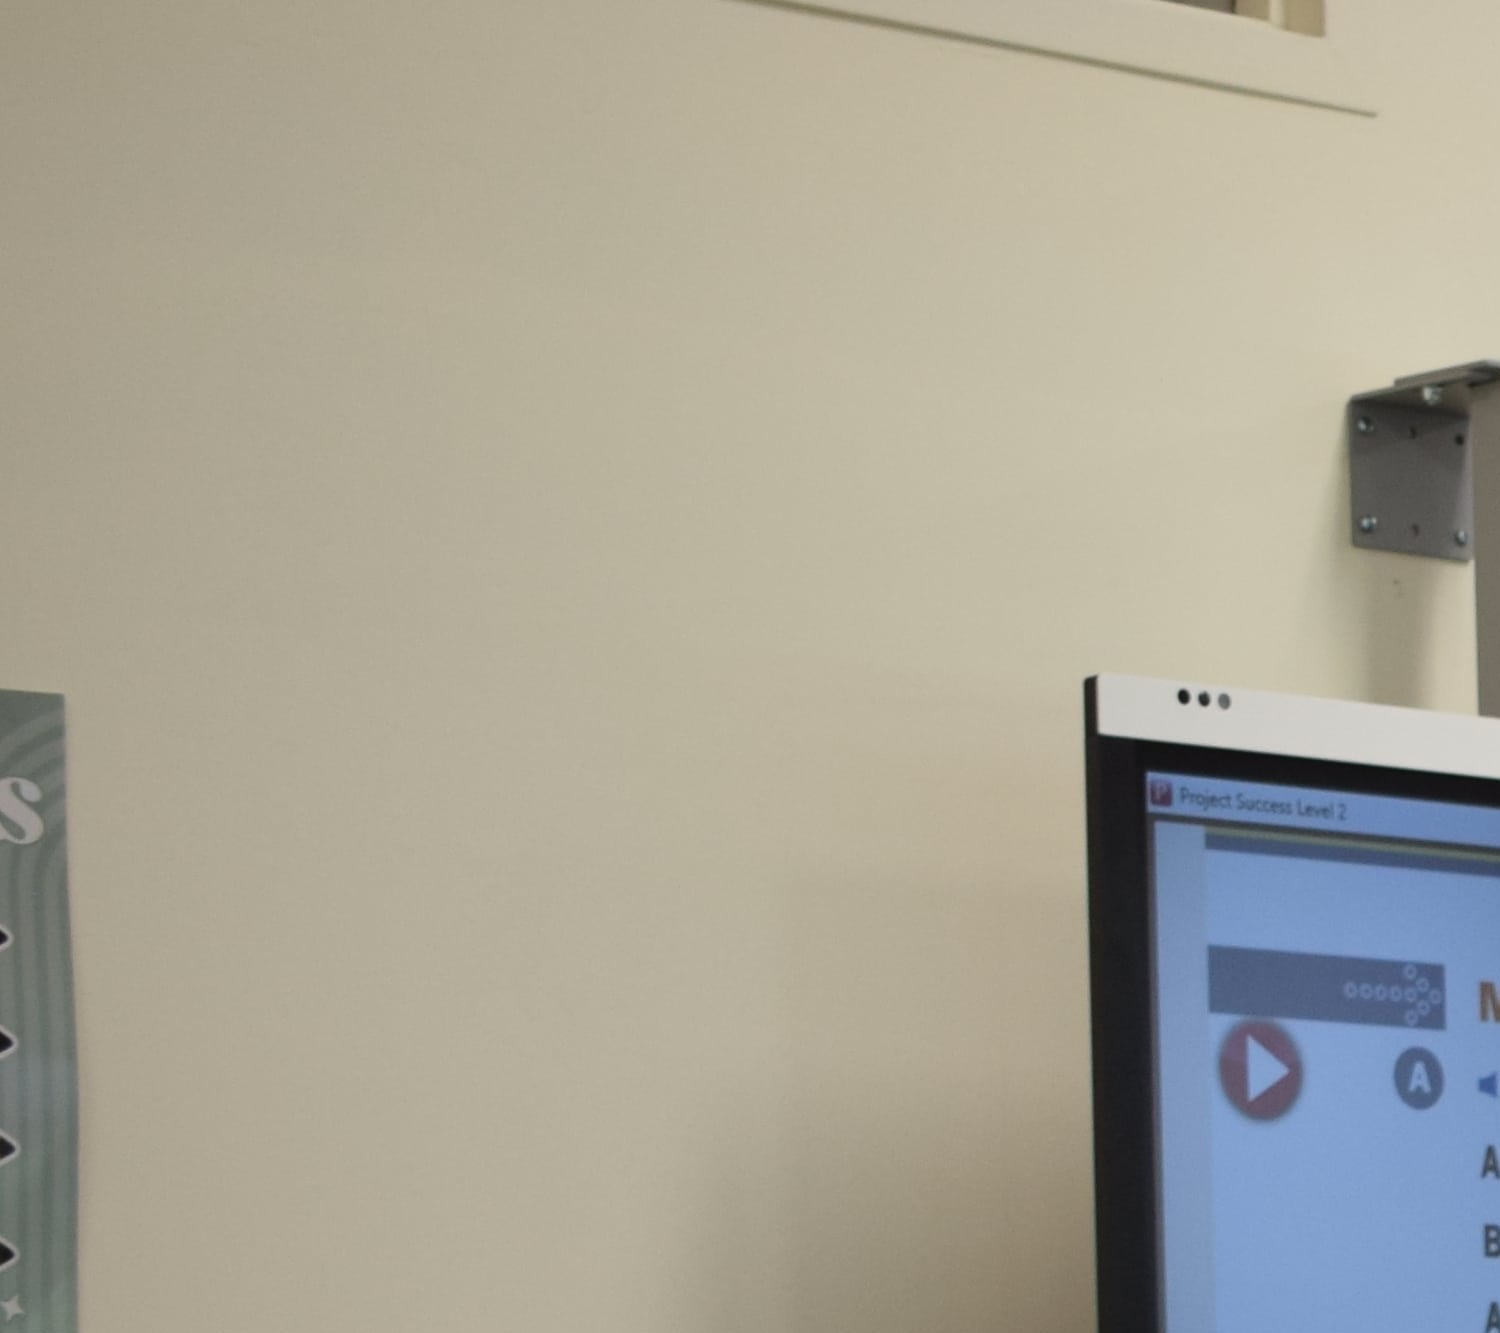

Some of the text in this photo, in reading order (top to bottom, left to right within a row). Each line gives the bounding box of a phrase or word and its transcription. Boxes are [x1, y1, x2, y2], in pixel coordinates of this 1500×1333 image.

[1179, 787, 1348, 821] Project Success Level 2
